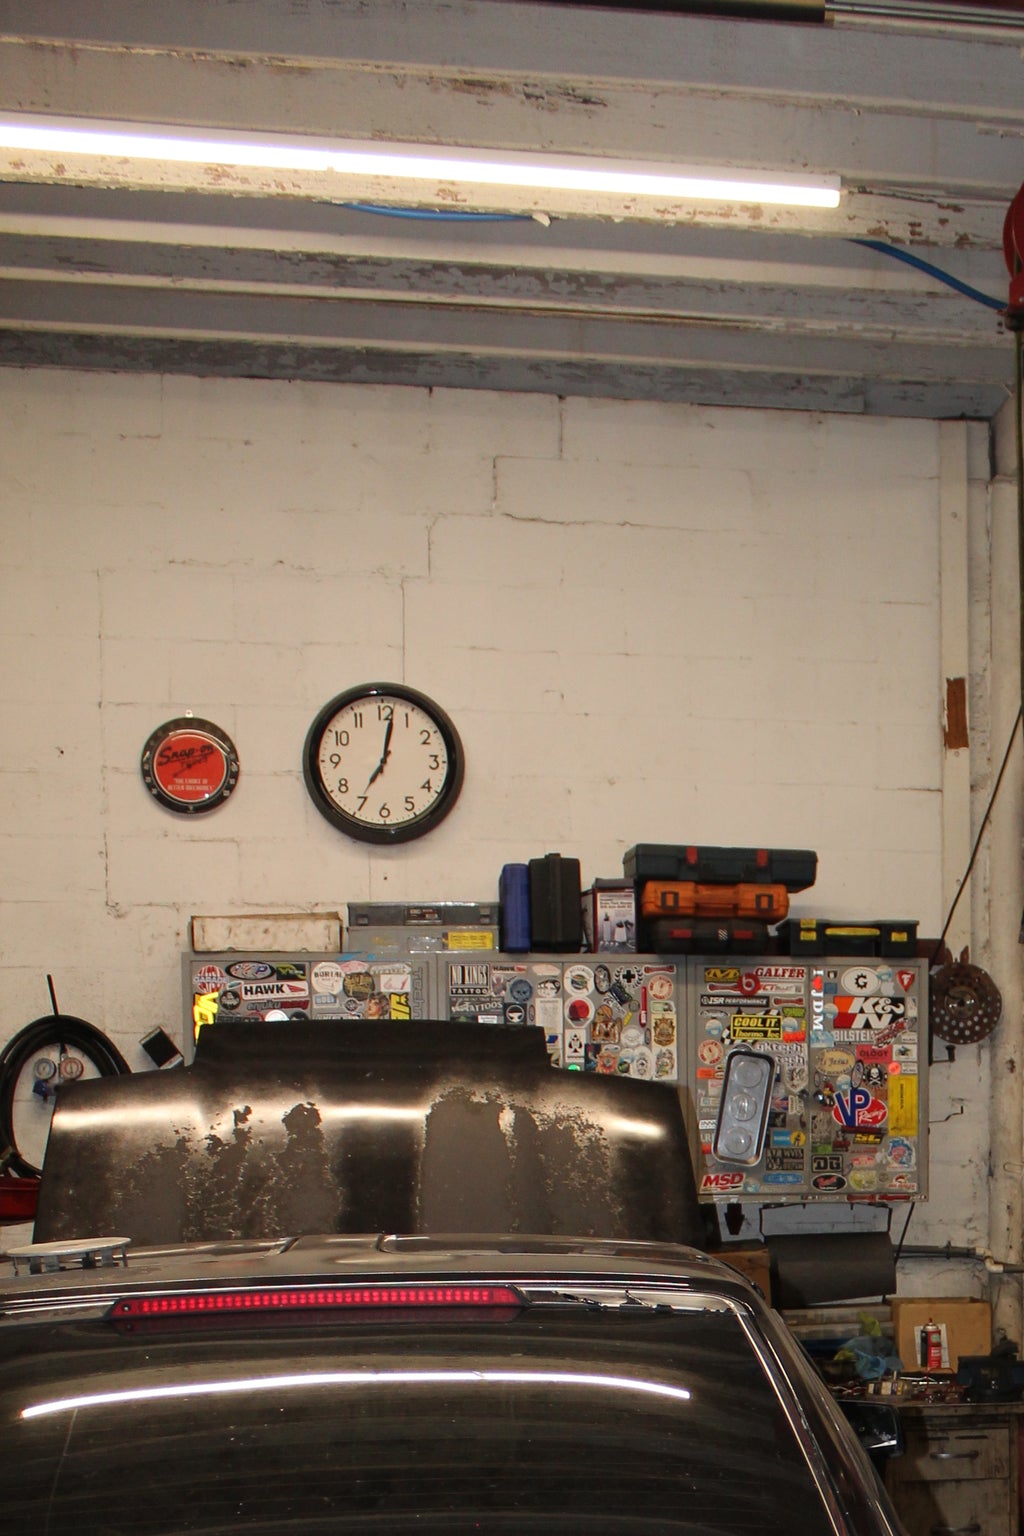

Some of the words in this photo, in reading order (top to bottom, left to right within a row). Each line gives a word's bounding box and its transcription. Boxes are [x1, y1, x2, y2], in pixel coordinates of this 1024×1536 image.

[354, 712, 363, 729] 11
[377, 704, 394, 721] 12
[335, 730, 350, 747] 10
[419, 729, 431, 746] 2
[329, 753, 342, 769] 9
[428, 754, 440, 770] 3
[338, 778, 349, 794] 8
[420, 778, 433, 793] 4
[357, 796, 368, 812] 7
[379, 802, 391, 818] 6
[404, 796, 416, 811] 5
[451, 965, 463, 985] NO
[464, 965, 488, 985] KINGS
[755, 967, 806, 978] GALFER
[244, 984, 286, 996] HAWK
[810, 989, 824, 1031] JDM
[848, 996, 905, 1029] K&N
[734, 1017, 763, 1027] COOL
[765, 1018, 778, 1028] IT
[834, 1087, 871, 1127] VP
[703, 1173, 745, 1188] MSD
